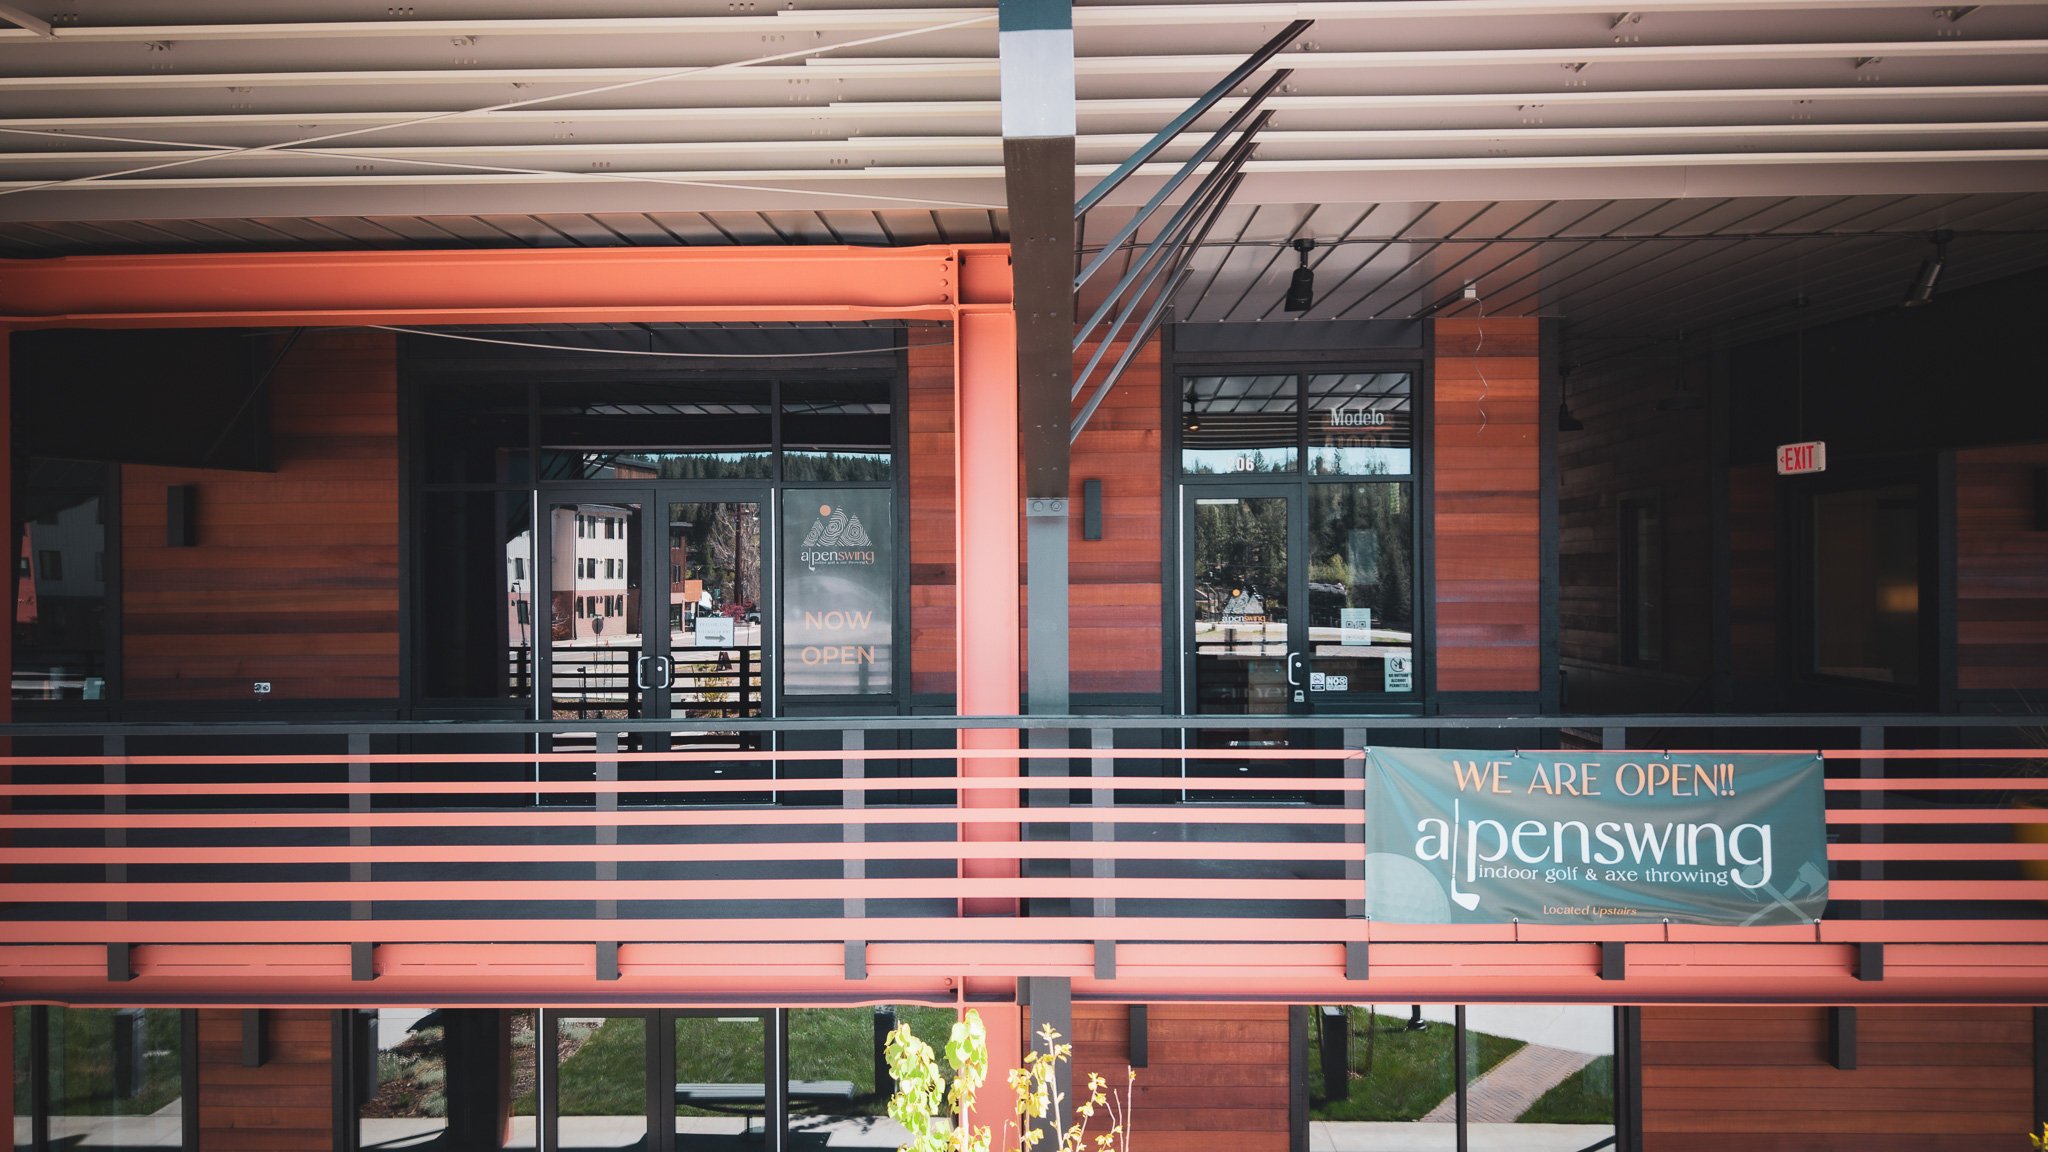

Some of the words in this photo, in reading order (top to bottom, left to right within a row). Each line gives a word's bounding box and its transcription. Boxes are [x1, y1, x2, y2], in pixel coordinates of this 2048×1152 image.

[1330, 407, 1385, 426] Modelo
[1227, 456, 1255, 472] 06
[1785, 445, 1814, 471] EXIT
[800, 547, 875, 572] alpenswing
[805, 610, 873, 630] NOW
[801, 645, 875, 665] OPEN
[1452, 760, 1512, 794] WE
[1527, 762, 1601, 796] ARE
[1615, 762, 1735, 797] OPEN!!
[1415, 798, 1772, 911] alpenswing
[1478, 864, 1539, 881] indoor
[1544, 866, 1579, 884] golf
[1585, 868, 1598, 881] &
[1605, 868, 1639, 882] axe
[1645, 867, 1728, 886] throwing
[1542, 904, 1590, 915] Located
[1592, 905, 1638, 918] Upstairs
